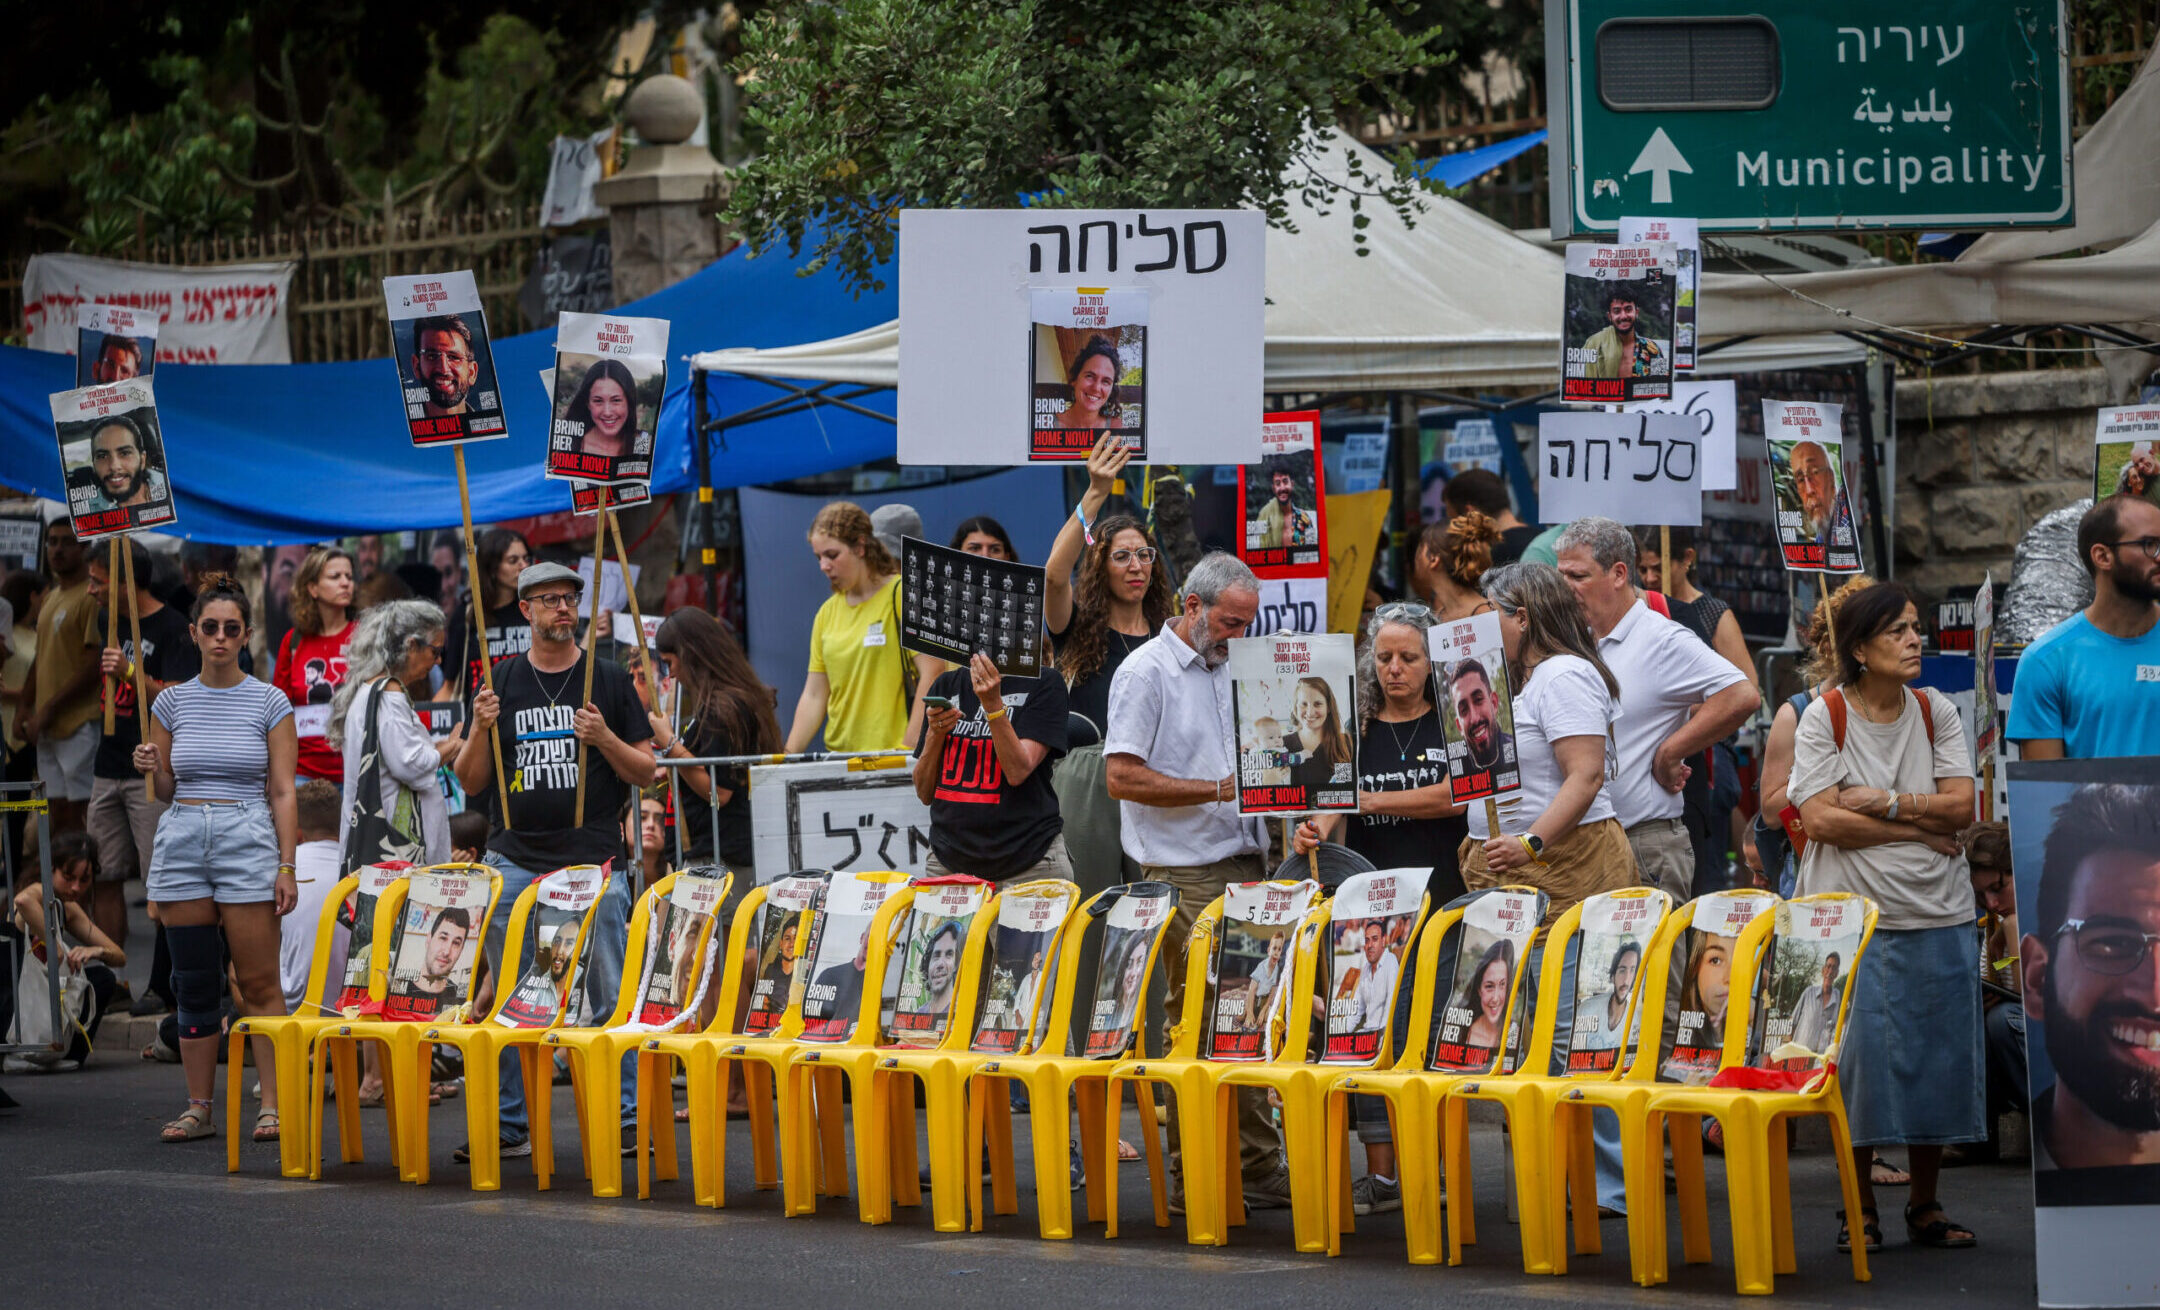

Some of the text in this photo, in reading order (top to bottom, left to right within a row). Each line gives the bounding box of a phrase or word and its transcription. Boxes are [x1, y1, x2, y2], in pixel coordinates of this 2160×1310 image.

[1837, 25, 1964, 66] עיריה
[1854, 87, 1953, 133] بلدية
[1736, 147, 2046, 193] Municipality
[1027, 213, 1227, 274] סליחה
[1589, 258, 1657, 268] HERSH GOLDBERG-POLIN
[412, 291, 448, 303] ALMOG SAROSI
[1072, 306, 1109, 315] CARMEL GAT
[1075, 316, 1093, 326] (40)
[597, 332, 633, 344] NAAMA LEVY
[613, 346, 632, 355] (20)
[1566, 348, 1598, 363] BRING
[1566, 363, 1585, 378] HIM
[1566, 379, 1592, 395] HOME
[1598, 379, 1624, 395] NOW!
[405, 387, 430, 404] BRING
[80, 400, 96, 410] MATAN
[408, 403, 425, 420] HIM
[1035, 398, 1065, 414] BRING
[411, 415, 462, 436] HOME NOW!
[554, 419, 585, 437] BRING
[1035, 414, 1054, 429] HER
[552, 435, 572, 452] HER
[1034, 431, 1062, 445] HOME
[1065, 430, 1094, 446] NOW!
[1548, 415, 1696, 482] סליחה
[551, 452, 580, 470] HOME
[581, 455, 611, 474] NOW!
[70, 484, 97, 501] BRING
[72, 501, 91, 516] HIM
[75, 508, 130, 531] HOME NOW!
[1779, 511, 1802, 527] BRING
[1781, 528, 1797, 543] HIM
[1784, 545, 1825, 561] HOME NOW!
[1273, 652, 1311, 663] SHIRI BIBAS
[1275, 664, 1295, 674] (33)
[2142, 666, 2160, 681] 33
[515, 705, 576, 735] מנצחים
[514, 738, 576, 768] כשכולם
[1448, 741, 1468, 759] BRING
[1242, 752, 1273, 770] BRING
[1450, 759, 1464, 776] HIM
[524, 763, 579, 790] חוזרים
[1242, 770, 1263, 786] HER
[1452, 775, 1472, 794] HOME
[1472, 770, 1491, 790] NOW!
[1242, 785, 1306, 805] HOME NOW!
[549, 891, 572, 902] MATAN
[1368, 889, 1396, 901] ELI SHARABI
[1246, 905, 1256, 921] 5
[1264, 902, 1278, 911] ARIEL
[1497, 909, 1514, 919] NAAMA
[1726, 913, 1739, 922] AGAM
[395, 968, 421, 982] BRING
[526, 975, 550, 990] BRING
[651, 973, 672, 987] BRING
[390, 980, 409, 994] HIM
[518, 988, 538, 1002] HIM
[756, 980, 774, 994] BRING
[807, 984, 837, 1001] BRING
[900, 982, 922, 998] BRING
[388, 995, 437, 1013] HOME NOW!
[805, 1000, 823, 1017] HIM
[898, 997, 912, 1011] HIM
[987, 999, 1006, 1014] BRING
[1096, 1000, 1115, 1016] BRING
[1218, 1000, 1245, 1016] BRING
[1330, 998, 1359, 1017] BRING
[894, 1014, 934, 1029] HOME NOW!
[983, 1014, 997, 1029] HIM
[1092, 1016, 1105, 1030] HER
[1216, 1016, 1233, 1032] HIM
[1329, 1016, 1346, 1034] HIM
[1446, 1008, 1473, 1026] BRING
[1575, 1015, 1598, 1032] BRING
[1679, 1011, 1704, 1028] BRING
[804, 1017, 848, 1034] HOME NOW!
[1442, 1024, 1459, 1042] HER
[1766, 1019, 1792, 1035] BRING
[977, 1030, 1017, 1045] HOME NOW!
[1215, 1034, 1260, 1050] HOME NOW!
[1328, 1034, 1377, 1053] HOME NOW!
[1572, 1034, 1587, 1050] HIM
[1676, 1028, 1692, 1044] HER
[1764, 1036, 1781, 1051] HIM
[1439, 1044, 1490, 1066] HOME NOW!
[1570, 1050, 1614, 1069] HOME NOW!
[1673, 1046, 1722, 1064] HOME NOW!
